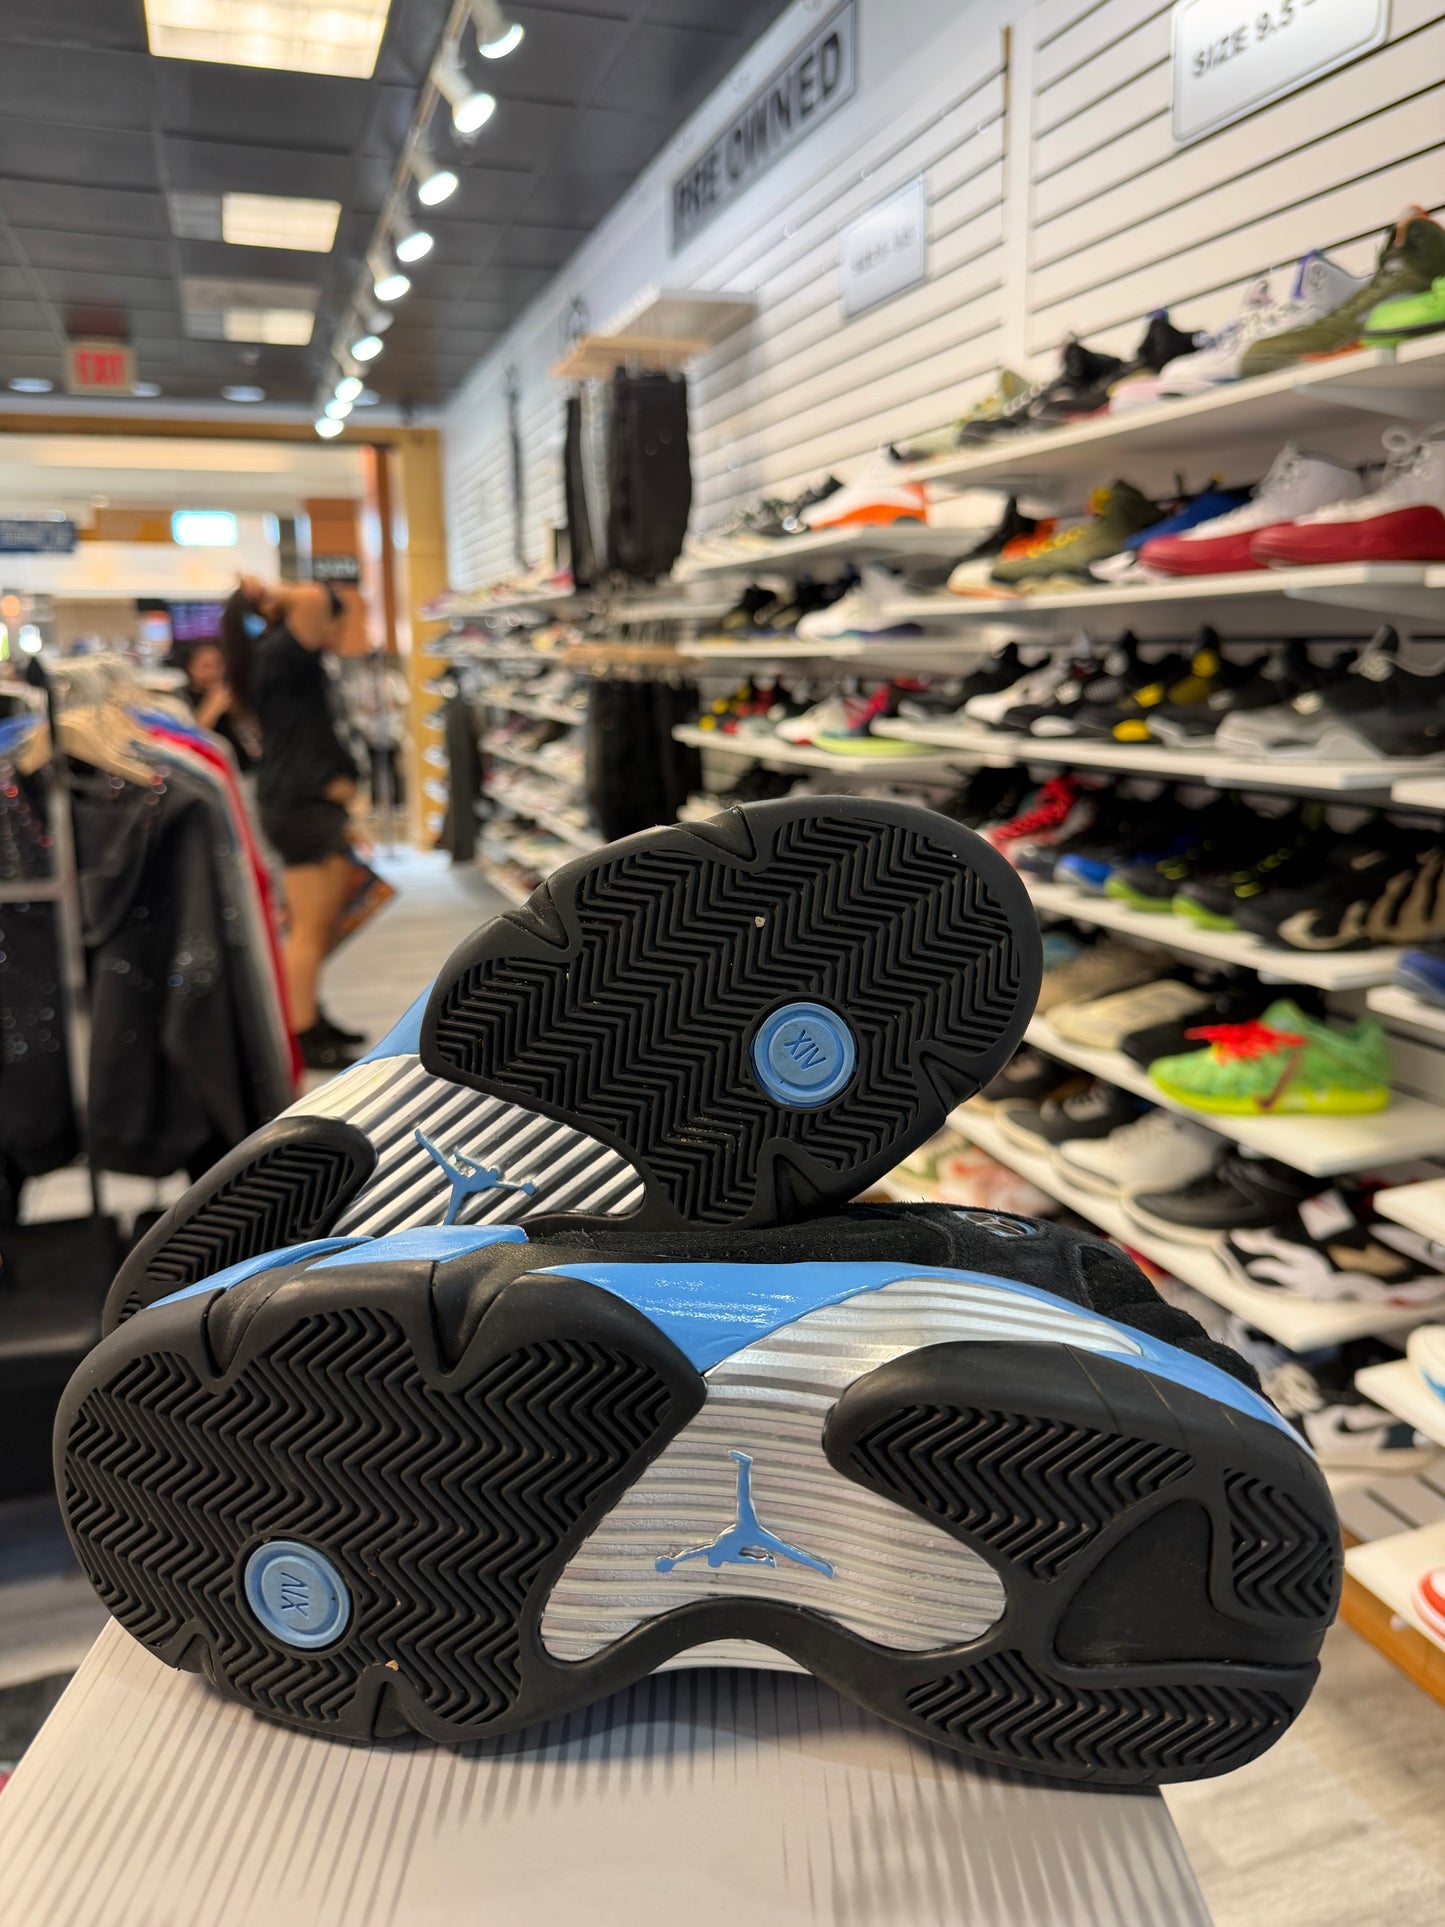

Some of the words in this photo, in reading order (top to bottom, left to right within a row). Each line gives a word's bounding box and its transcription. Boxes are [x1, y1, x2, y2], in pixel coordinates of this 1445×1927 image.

[1191, 24, 1249, 78] SIZE
[1255, 0, 1296, 42] 9.5
[677, 144, 722, 220] PRE
[724, 30, 841, 185] OWNED
[75, 350, 125, 386] EXIT
[784, 1029, 827, 1072] XIV
[280, 1571, 310, 1620] XIV
